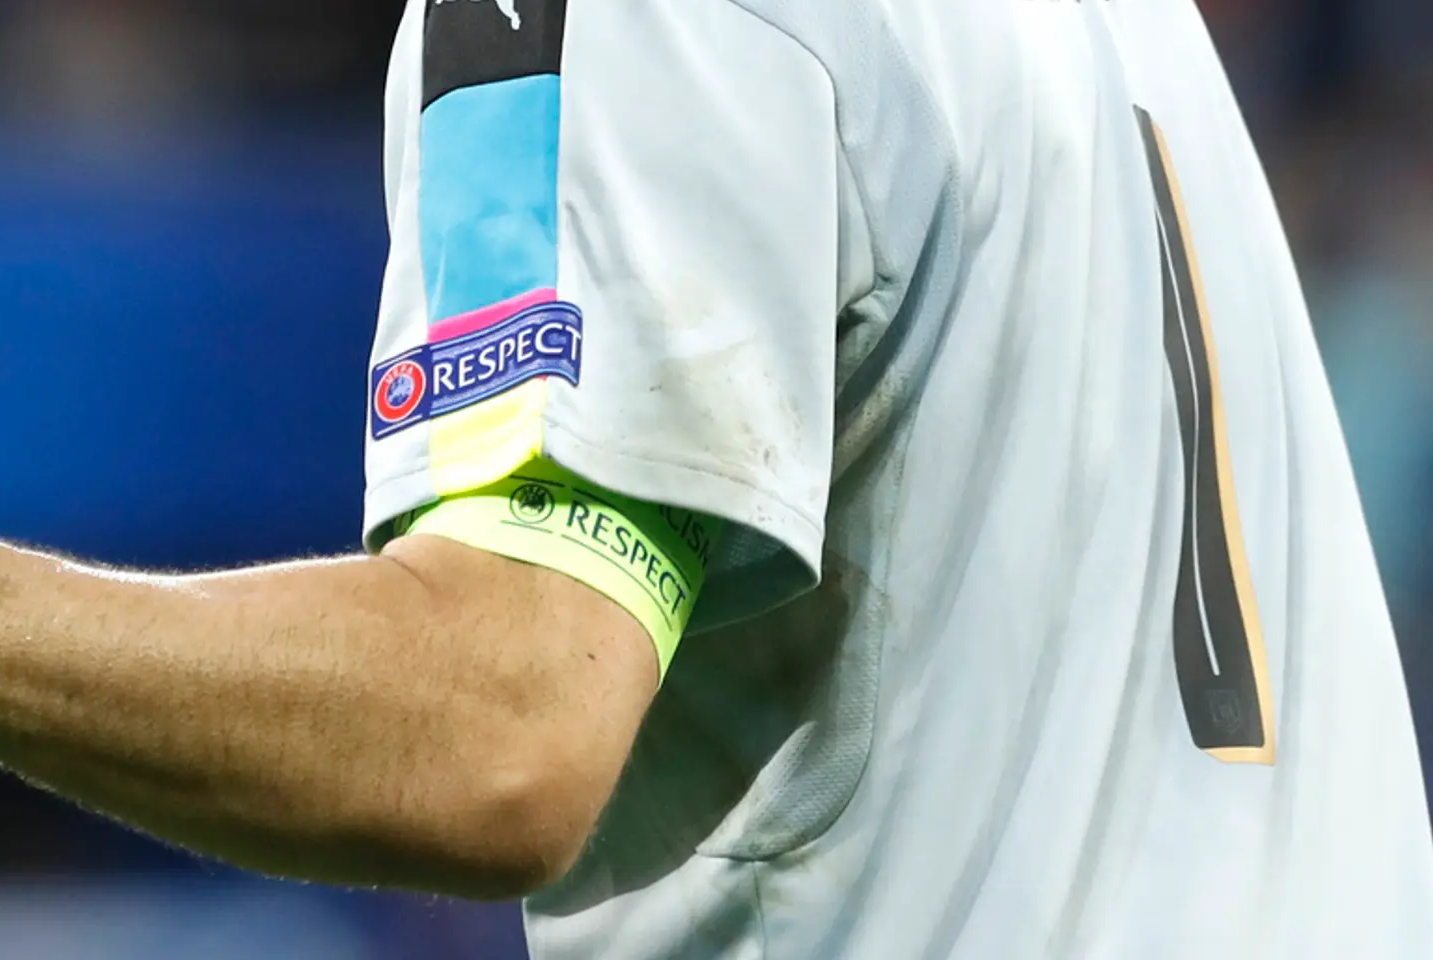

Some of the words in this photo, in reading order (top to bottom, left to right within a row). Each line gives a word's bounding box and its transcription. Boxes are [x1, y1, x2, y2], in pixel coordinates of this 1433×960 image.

[433, 323, 582, 395] RESPECT
[1133, 104, 1275, 766] 1
[566, 500, 686, 615] RESPECT
